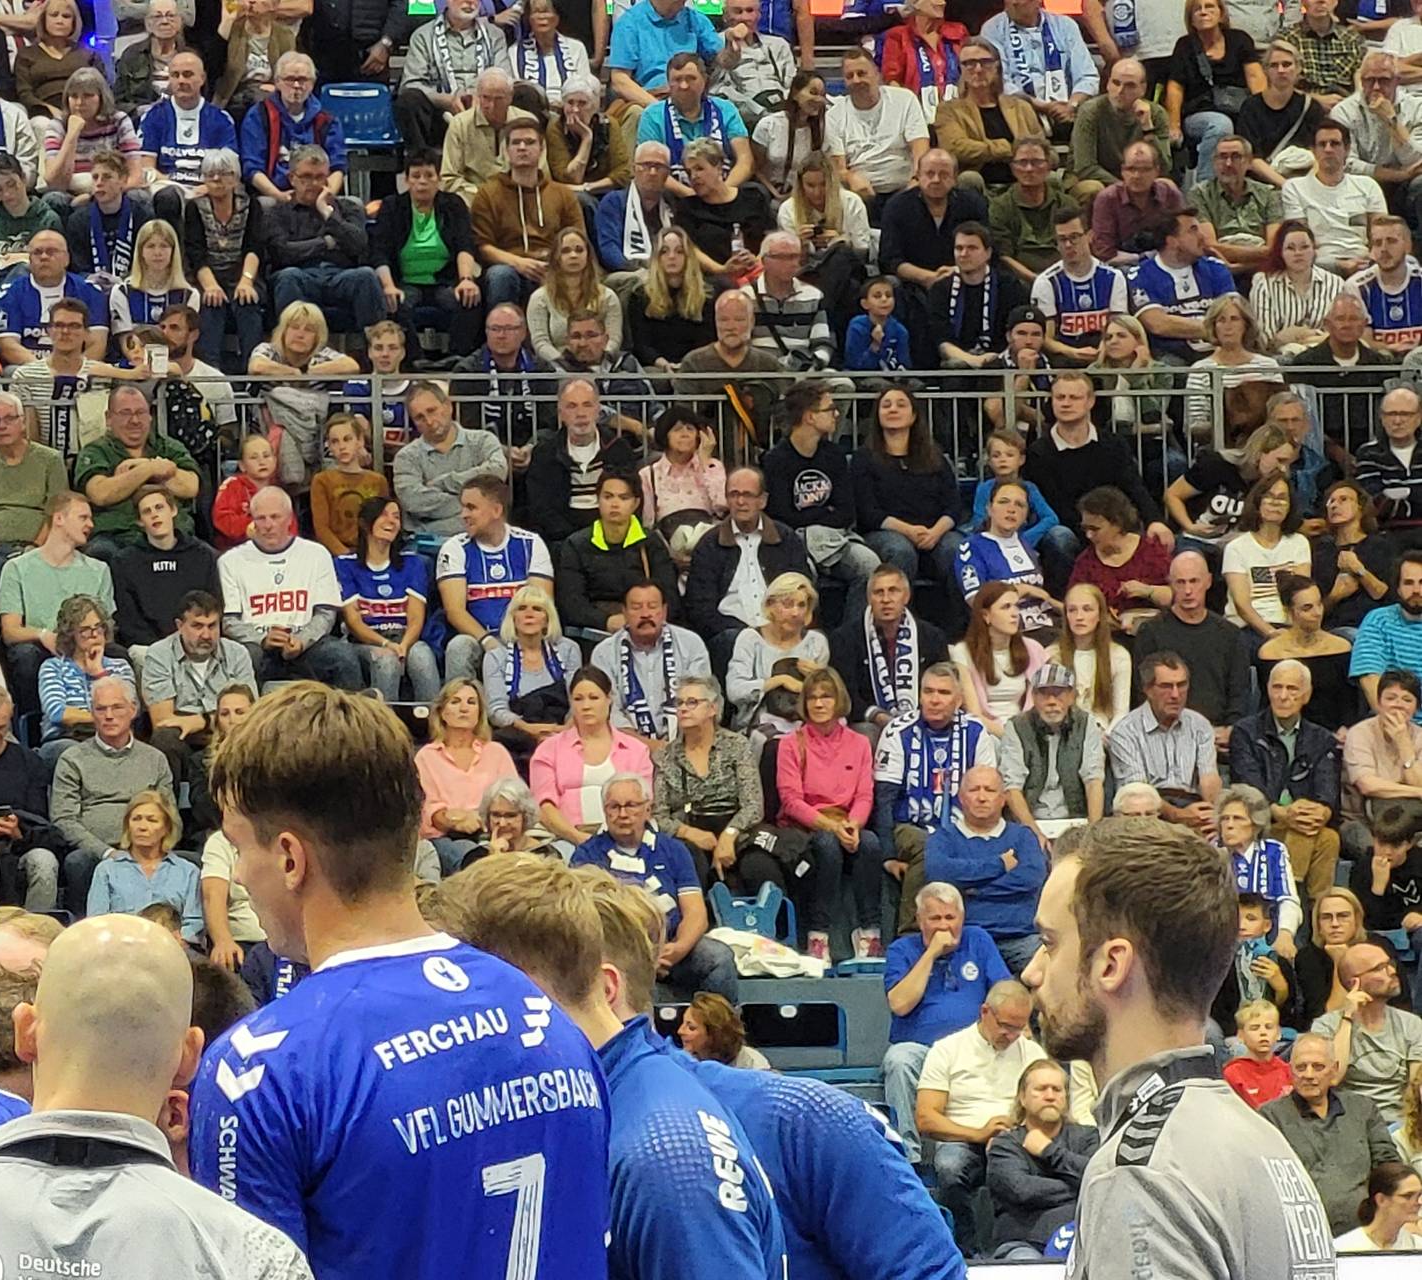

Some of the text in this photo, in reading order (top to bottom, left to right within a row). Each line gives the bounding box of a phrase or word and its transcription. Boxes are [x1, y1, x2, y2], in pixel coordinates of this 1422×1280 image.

[152, 560, 177, 572] KITH
[249, 590, 309, 617] SABO
[374, 1007, 509, 1070] FERCHAU
[393, 1068, 602, 1155] VFL GUMMERSBACH
[219, 1114, 239, 1205] SCHWA
[697, 1110, 747, 1213] REWE
[481, 1152, 546, 1280] 7
[18, 1253, 102, 1277] Deutsche
